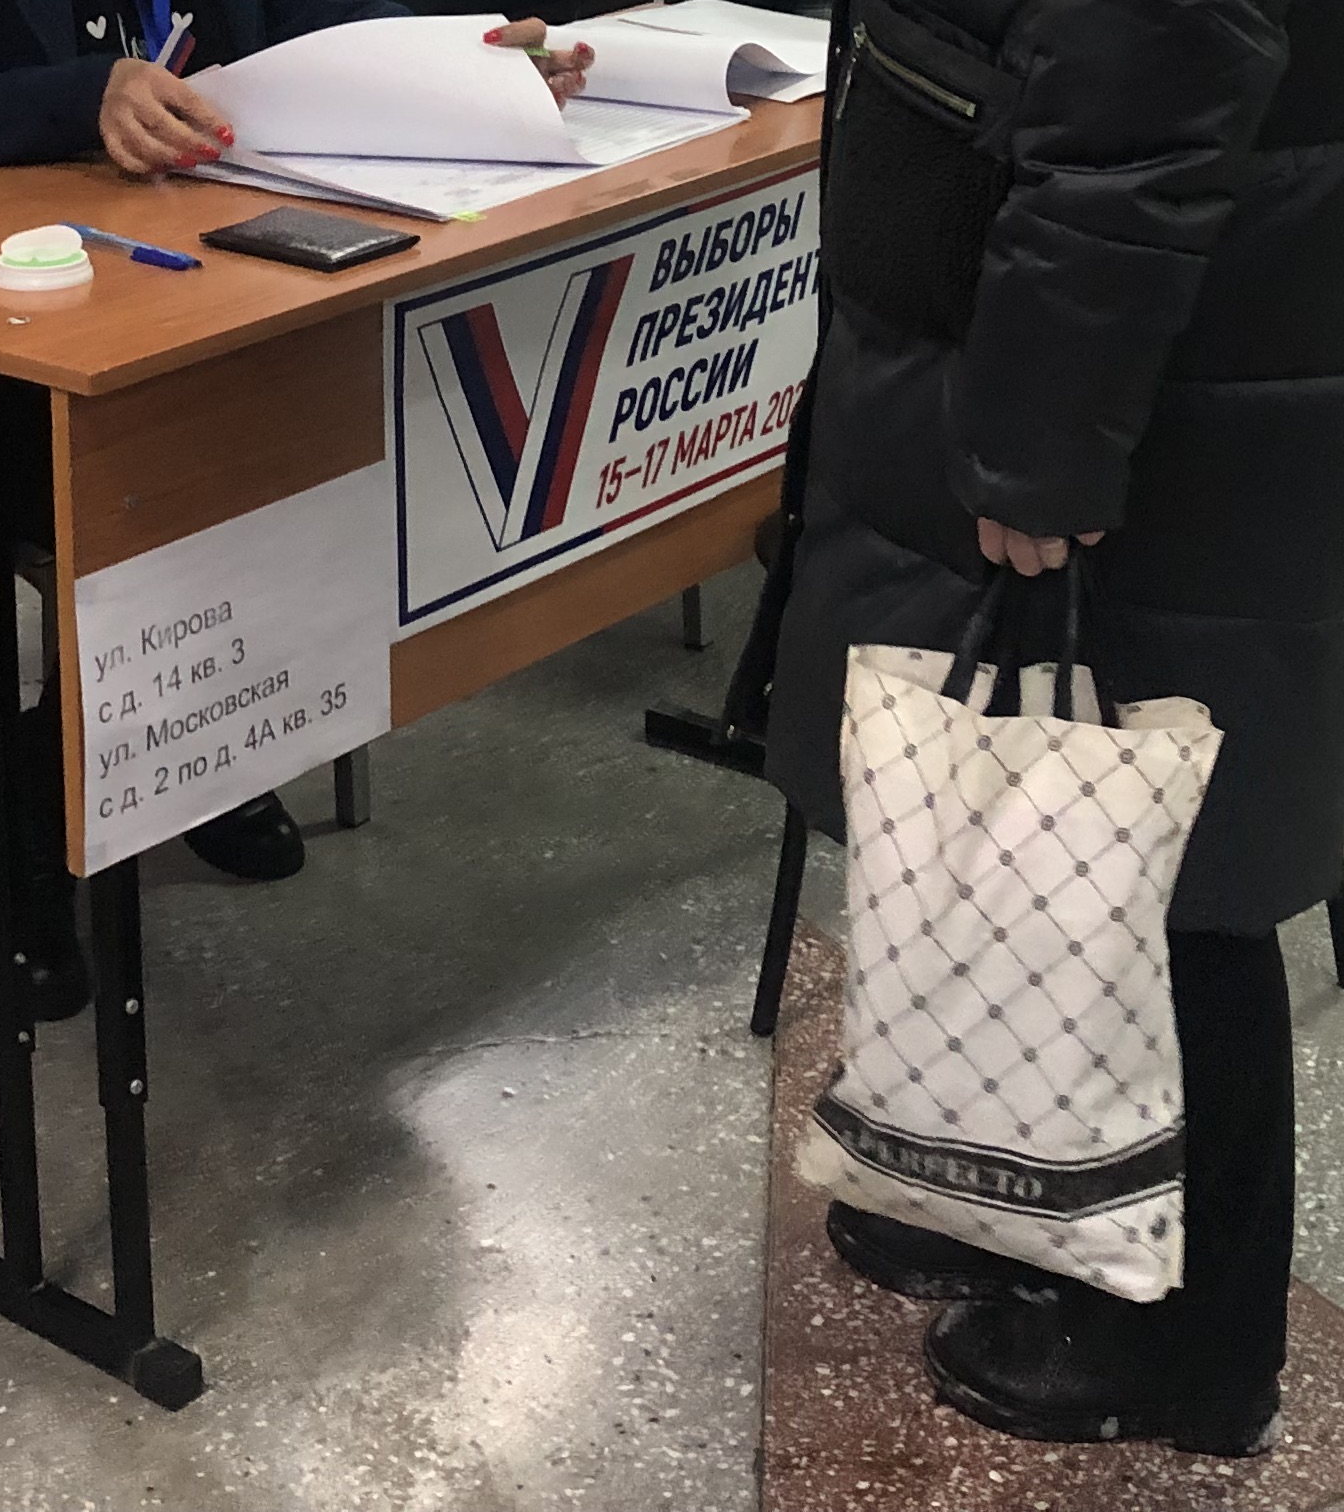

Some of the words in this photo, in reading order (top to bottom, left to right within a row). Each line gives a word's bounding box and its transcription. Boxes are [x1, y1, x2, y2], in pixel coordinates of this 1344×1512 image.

[648, 191, 805, 293] ВЫБОРЫ
[626, 250, 820, 368] ПРЕЗИДЕНТ
[609, 338, 759, 443] РОССИИ
[672, 399, 758, 477] МАРТА
[761, 379, 806, 436] 202
[94, 643, 131, 682] ул.
[140, 599, 233, 656] Кирова
[99, 701, 113, 724] с
[119, 688, 143, 719] д.
[153, 666, 182, 698] 14
[190, 656, 222, 684] кв.
[231, 637, 246, 665] 3
[99, 742, 136, 780] ул.
[146, 669, 290, 752] Московская
[99, 796, 113, 819] с
[120, 784, 143, 812] д.
[153, 767, 171, 795] 2
[177, 755, 208, 785] по
[215, 745, 237, 773] д.
[244, 719, 277, 751] 4А
[282, 710, 313, 736] кв.
[320, 683, 348, 716] 35
